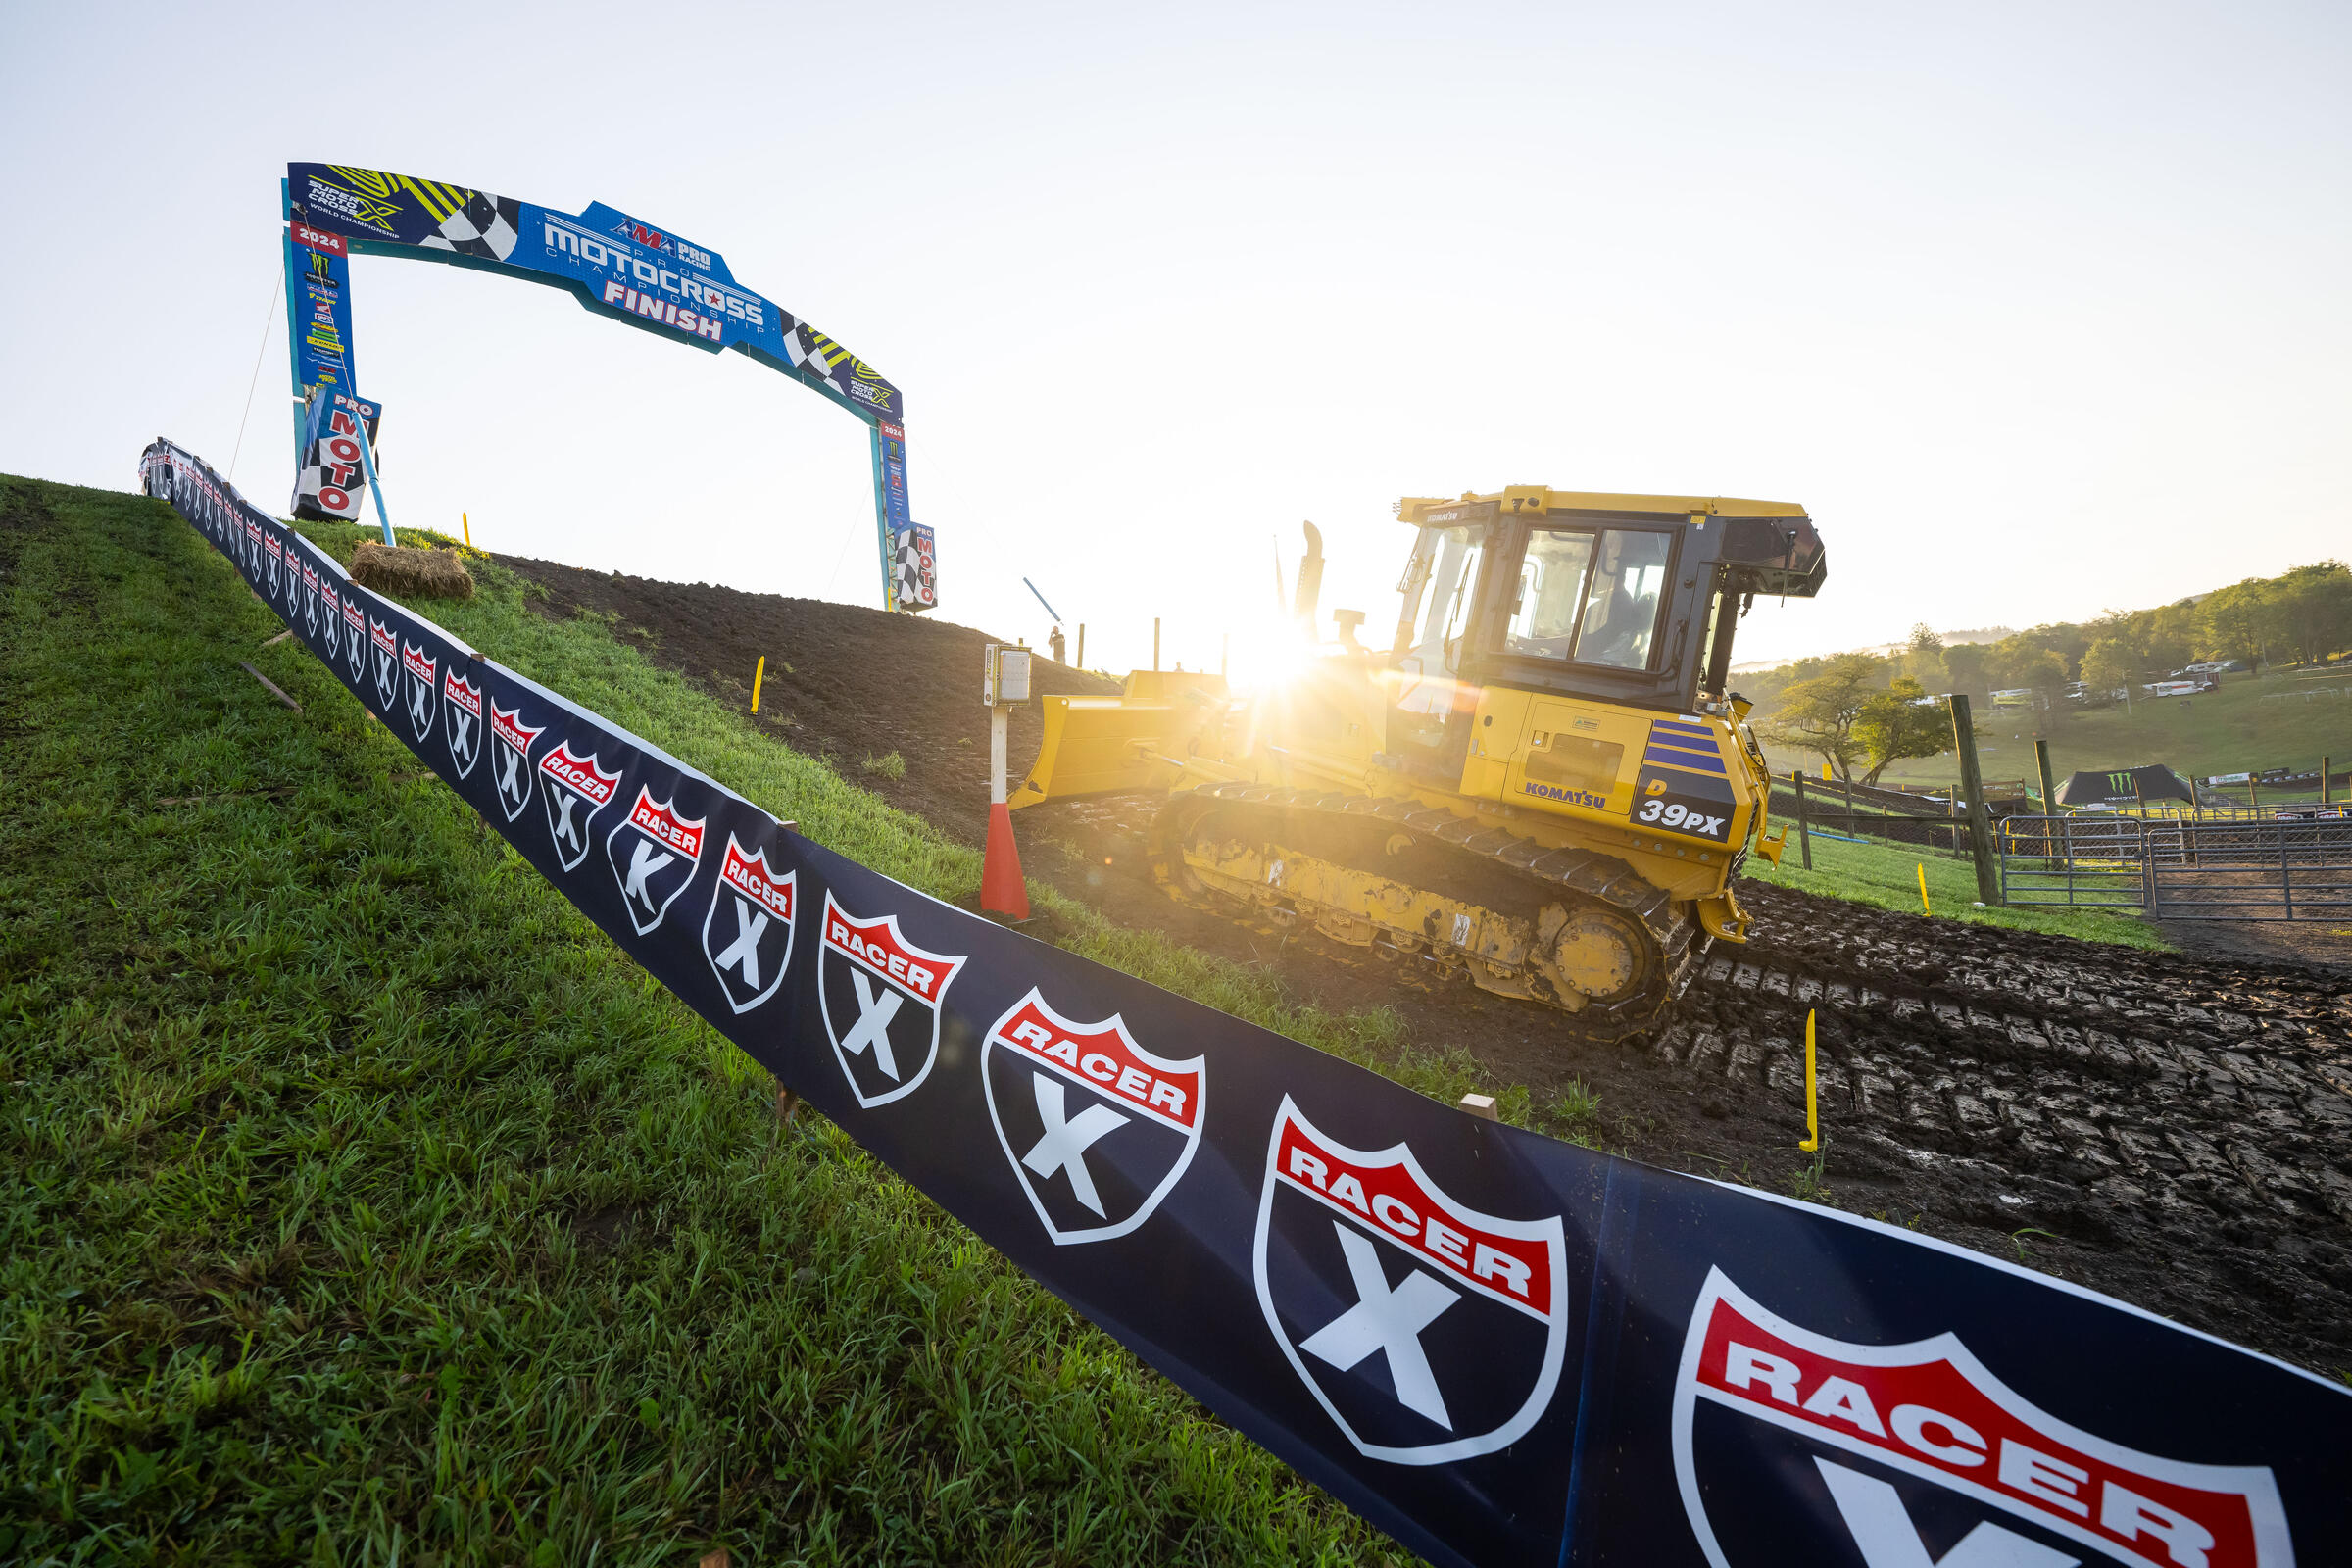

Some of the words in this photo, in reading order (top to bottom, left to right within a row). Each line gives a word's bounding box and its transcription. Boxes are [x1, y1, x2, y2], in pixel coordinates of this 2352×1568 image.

[308, 180, 360, 204] SUPER
[308, 193, 358, 216] CROSS
[312, 187, 358, 209] MOTO
[299, 228, 340, 250] 2024
[310, 203, 339, 218] WORLD
[340, 214, 400, 239] CHAMPIONSHIP
[610, 218, 677, 258] AMA
[678, 241, 711, 266] PRO
[678, 253, 711, 272] RACING
[544, 222, 764, 326] MOTOCROSS
[546, 247, 764, 334] CHAMPIONSHIP
[604, 280, 723, 342] FINISH
[334, 394, 373, 416] PRO
[851, 380, 874, 392] SUPER
[851, 389, 873, 402] CROSS
[853, 385, 873, 396] MOTO
[885, 425, 902, 438] 2024
[318, 407, 369, 511] MOTO
[917, 526, 933, 537] PRO
[917, 537, 934, 603] MOTO
[325, 605, 336, 645] X
[344, 609, 364, 630] RACER
[348, 625, 361, 669] X
[372, 630, 394, 652] RACER
[378, 649, 392, 696] X
[405, 656, 432, 680] RACER
[412, 675, 427, 726] X
[448, 684, 479, 713] RACER
[453, 706, 472, 762] X
[493, 716, 526, 750] RACER
[500, 741, 521, 805] X
[545, 756, 610, 800] RACER
[1644, 778, 1668, 796] D
[1525, 782, 1606, 808] KOMATSU
[550, 782, 581, 853] X
[635, 807, 697, 854] RACER
[1638, 799, 1726, 836] 39PX
[727, 858, 788, 914] RACER
[714, 895, 769, 992] X
[831, 920, 935, 995] RACER
[840, 965, 905, 1083] X
[1011, 1019, 1187, 1117] RACER
[1021, 1070, 1132, 1221] X
[1289, 1145, 1533, 1298] RACER
[1298, 1218, 1463, 1433] X
[1724, 1340, 2217, 1568] RACER
